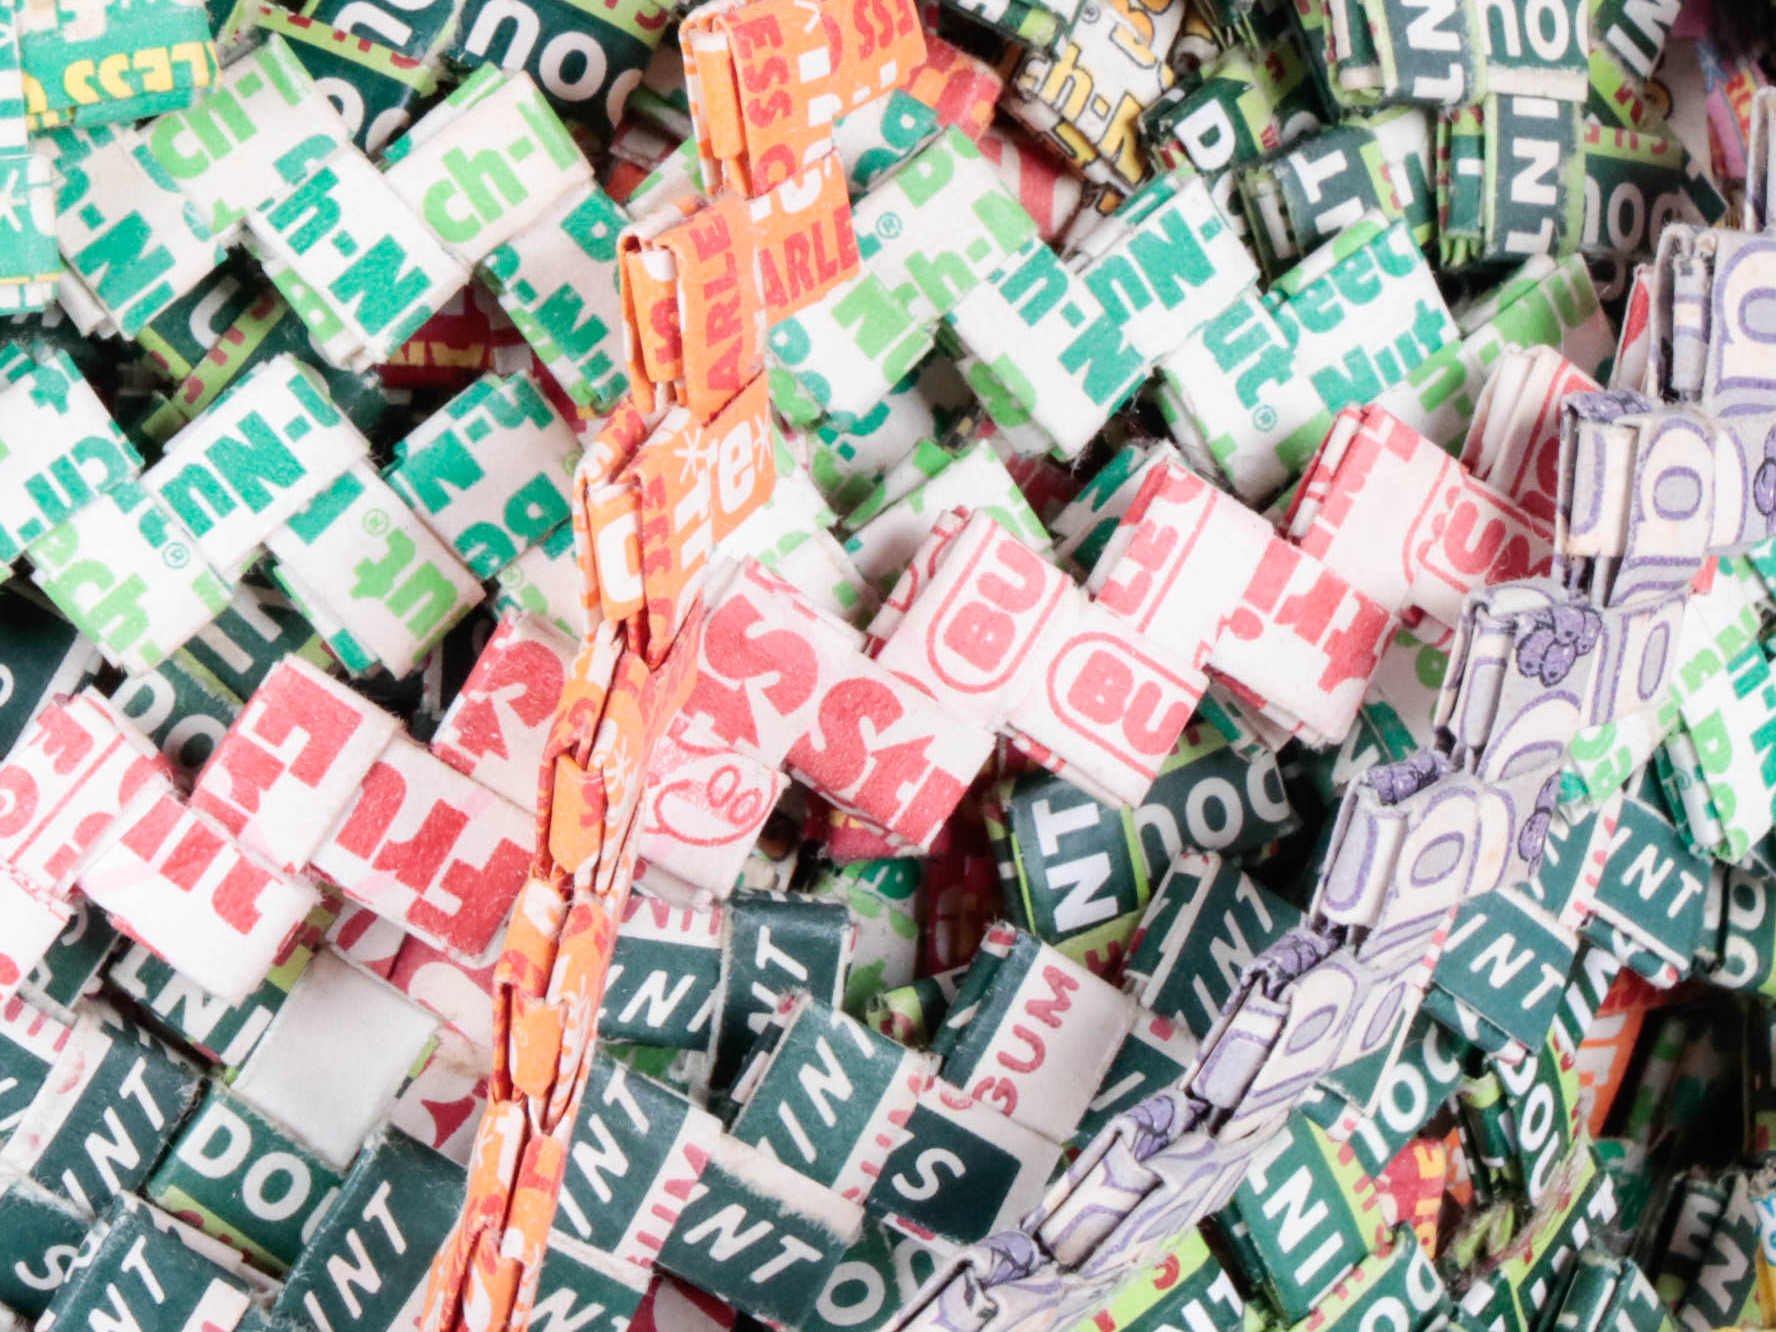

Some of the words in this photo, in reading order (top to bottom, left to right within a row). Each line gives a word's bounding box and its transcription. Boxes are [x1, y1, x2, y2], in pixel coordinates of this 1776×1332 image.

[734, 16, 793, 128] ESS
[941, 537, 1048, 674] BU
[1066, 648, 1193, 756] BU
[1031, 799, 1119, 933] NT
[1443, 914, 1567, 1013] INT
[969, 964, 1083, 1119] GUM
[60, 1056, 165, 1222] INT
[556, 1070, 649, 1240] INT
